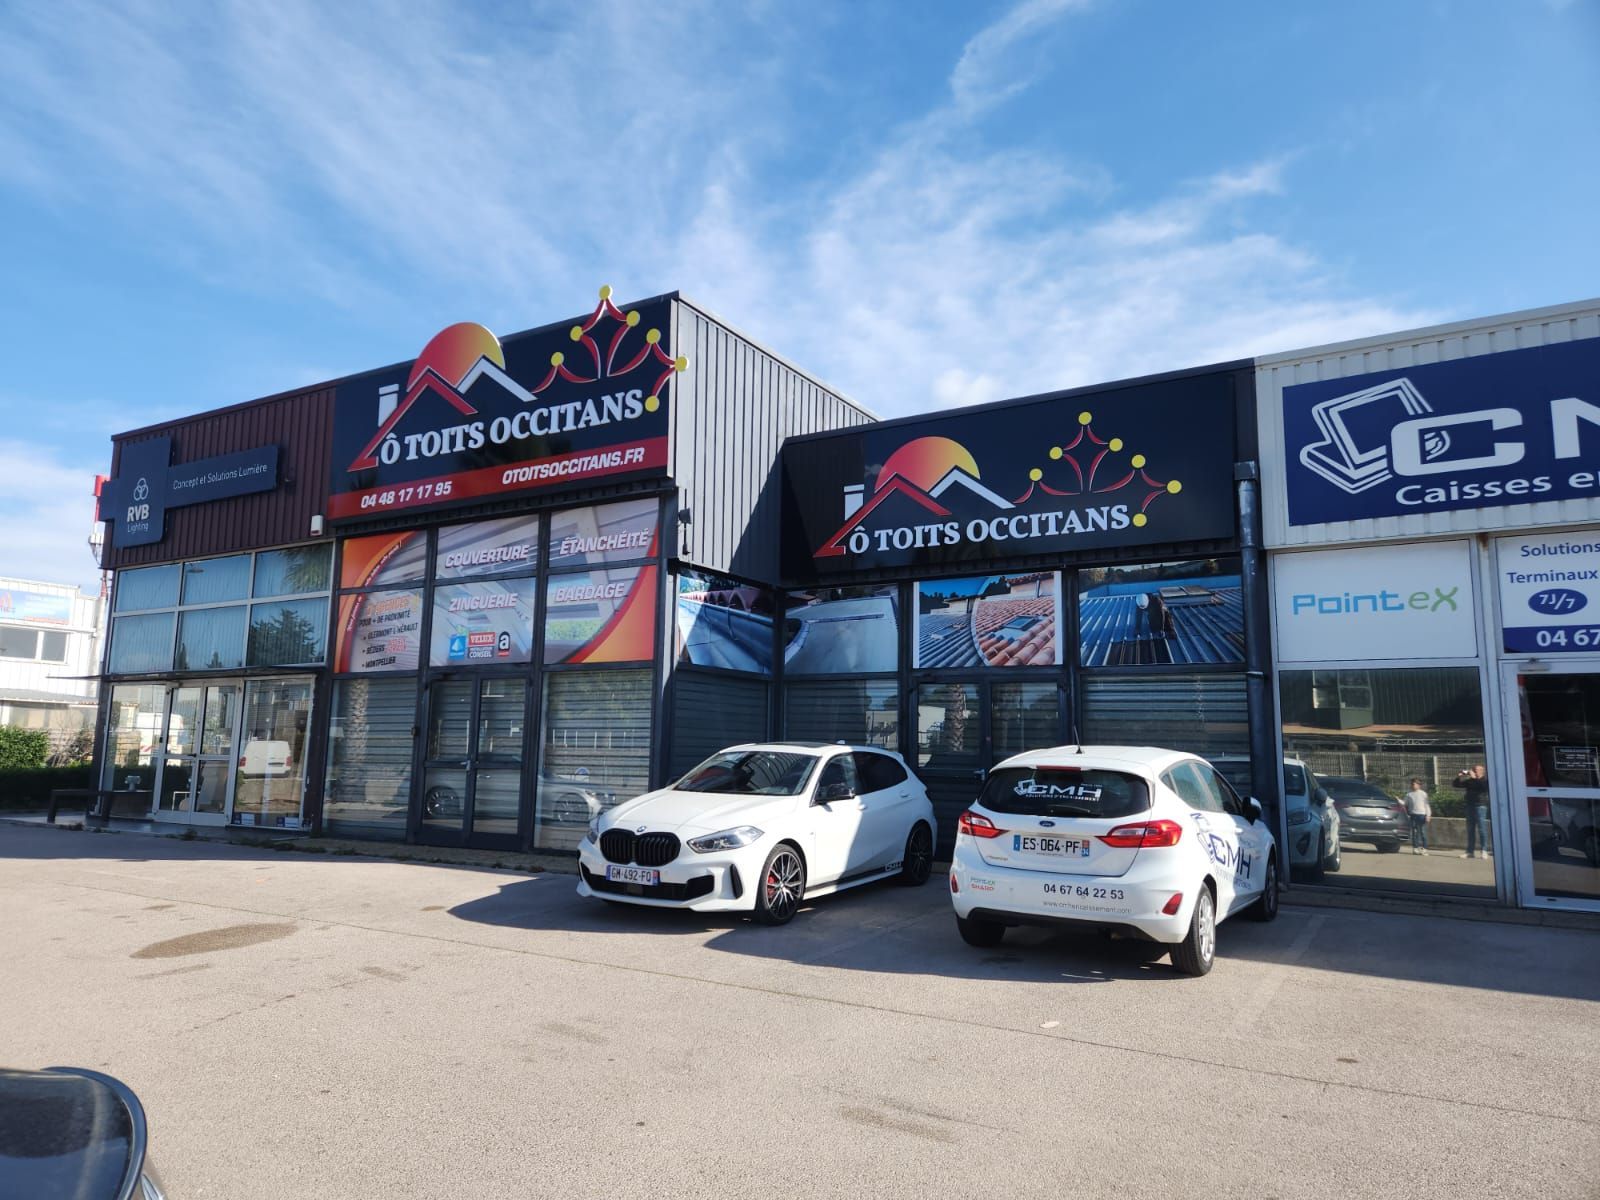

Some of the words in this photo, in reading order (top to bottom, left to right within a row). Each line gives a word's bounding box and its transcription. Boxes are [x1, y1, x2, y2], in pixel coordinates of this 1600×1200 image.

[380, 434, 400, 465] Ô
[404, 421, 485, 461] TOITS
[490, 388, 644, 445] OCCITANS
[502, 446, 645, 485] OTOITSOCCITANS.FR
[173, 477, 199, 490] Concept
[199, 474, 207, 484] et
[207, 468, 238, 483] Solutions
[238, 464, 268, 477] Lumière
[361, 494, 377, 508] 04
[379, 491, 395, 505] 48
[398, 487, 414, 502] 17
[416, 484, 433, 499] 17
[434, 481, 452, 496] 95
[1396, 475, 1552, 506] Caisses
[127, 504, 150, 522] RVB
[127, 522, 149, 534] Lighting
[849, 526, 870, 554] Ô
[874, 522, 961, 552] TOITS
[966, 505, 1131, 543] OCCITANS
[559, 528, 650, 556] ÉTANCHÉITÉ
[1521, 542, 1600, 557] Solutions
[445, 544, 530, 568] COUVERTURE
[1506, 570, 1598, 584] Terminaux
[448, 592, 519, 612] ZINGUERIE
[555, 583, 626, 602] BARDAGE
[1539, 593, 1576, 610] 7J/7
[1536, 629, 1567, 647] 04
[1573, 629, 1600, 647] 67
[1027, 785, 1102, 798] CMH
[1209, 833, 1252, 879] CMH
[1043, 883, 1056, 893] 04
[1059, 885, 1072, 895] 67
[1076, 886, 1089, 897] 64
[1093, 888, 1107, 898] 22
[1110, 889, 1124, 900] 53
